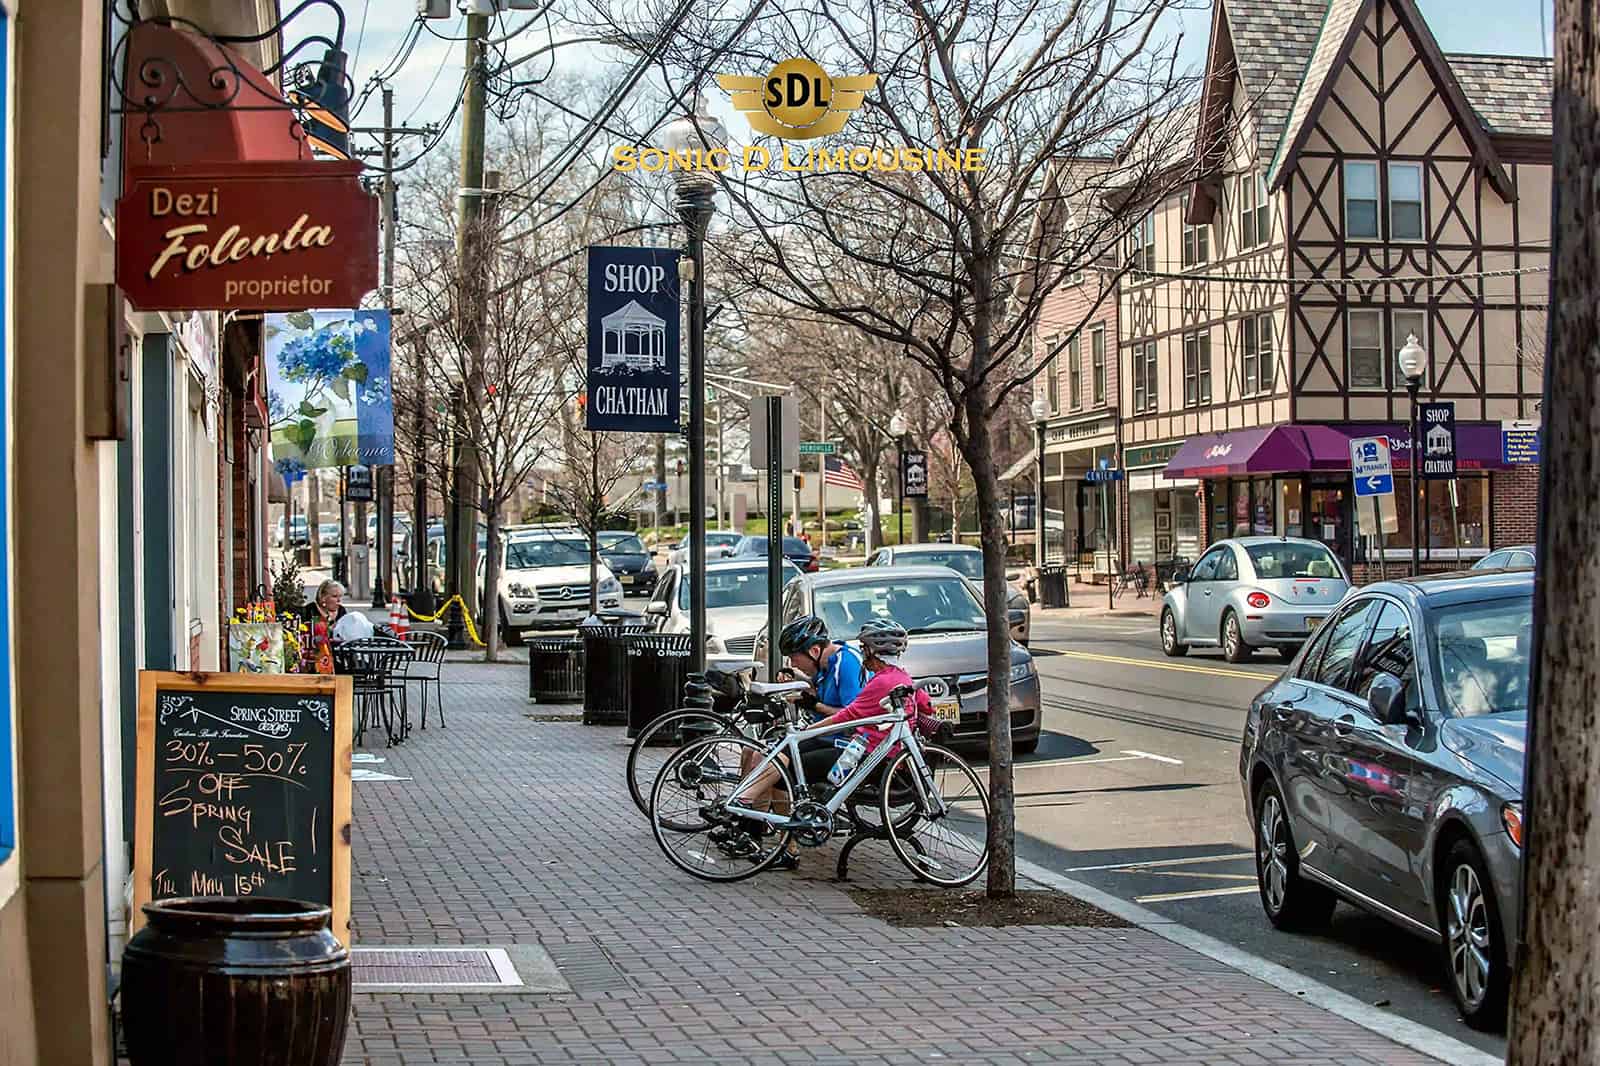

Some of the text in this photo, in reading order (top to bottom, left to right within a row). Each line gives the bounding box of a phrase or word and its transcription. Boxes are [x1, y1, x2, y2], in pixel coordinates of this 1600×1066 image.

[152, 188, 219, 216] Dezi
[149, 214, 335, 279] Folenta
[225, 275, 333, 302] proprietor
[604, 263, 665, 294] SHOP
[595, 385, 669, 416] CHATHAM
[1426, 408, 1450, 423] SHOP
[1424, 460, 1454, 473] CHATHAM
[230, 706, 302, 723] SPRING STREET
[199, 772, 250, 801] OFF
[159, 779, 251, 833] SPRING
[218, 825, 297, 876] SALE
[235, 871, 265, 896] 15th
